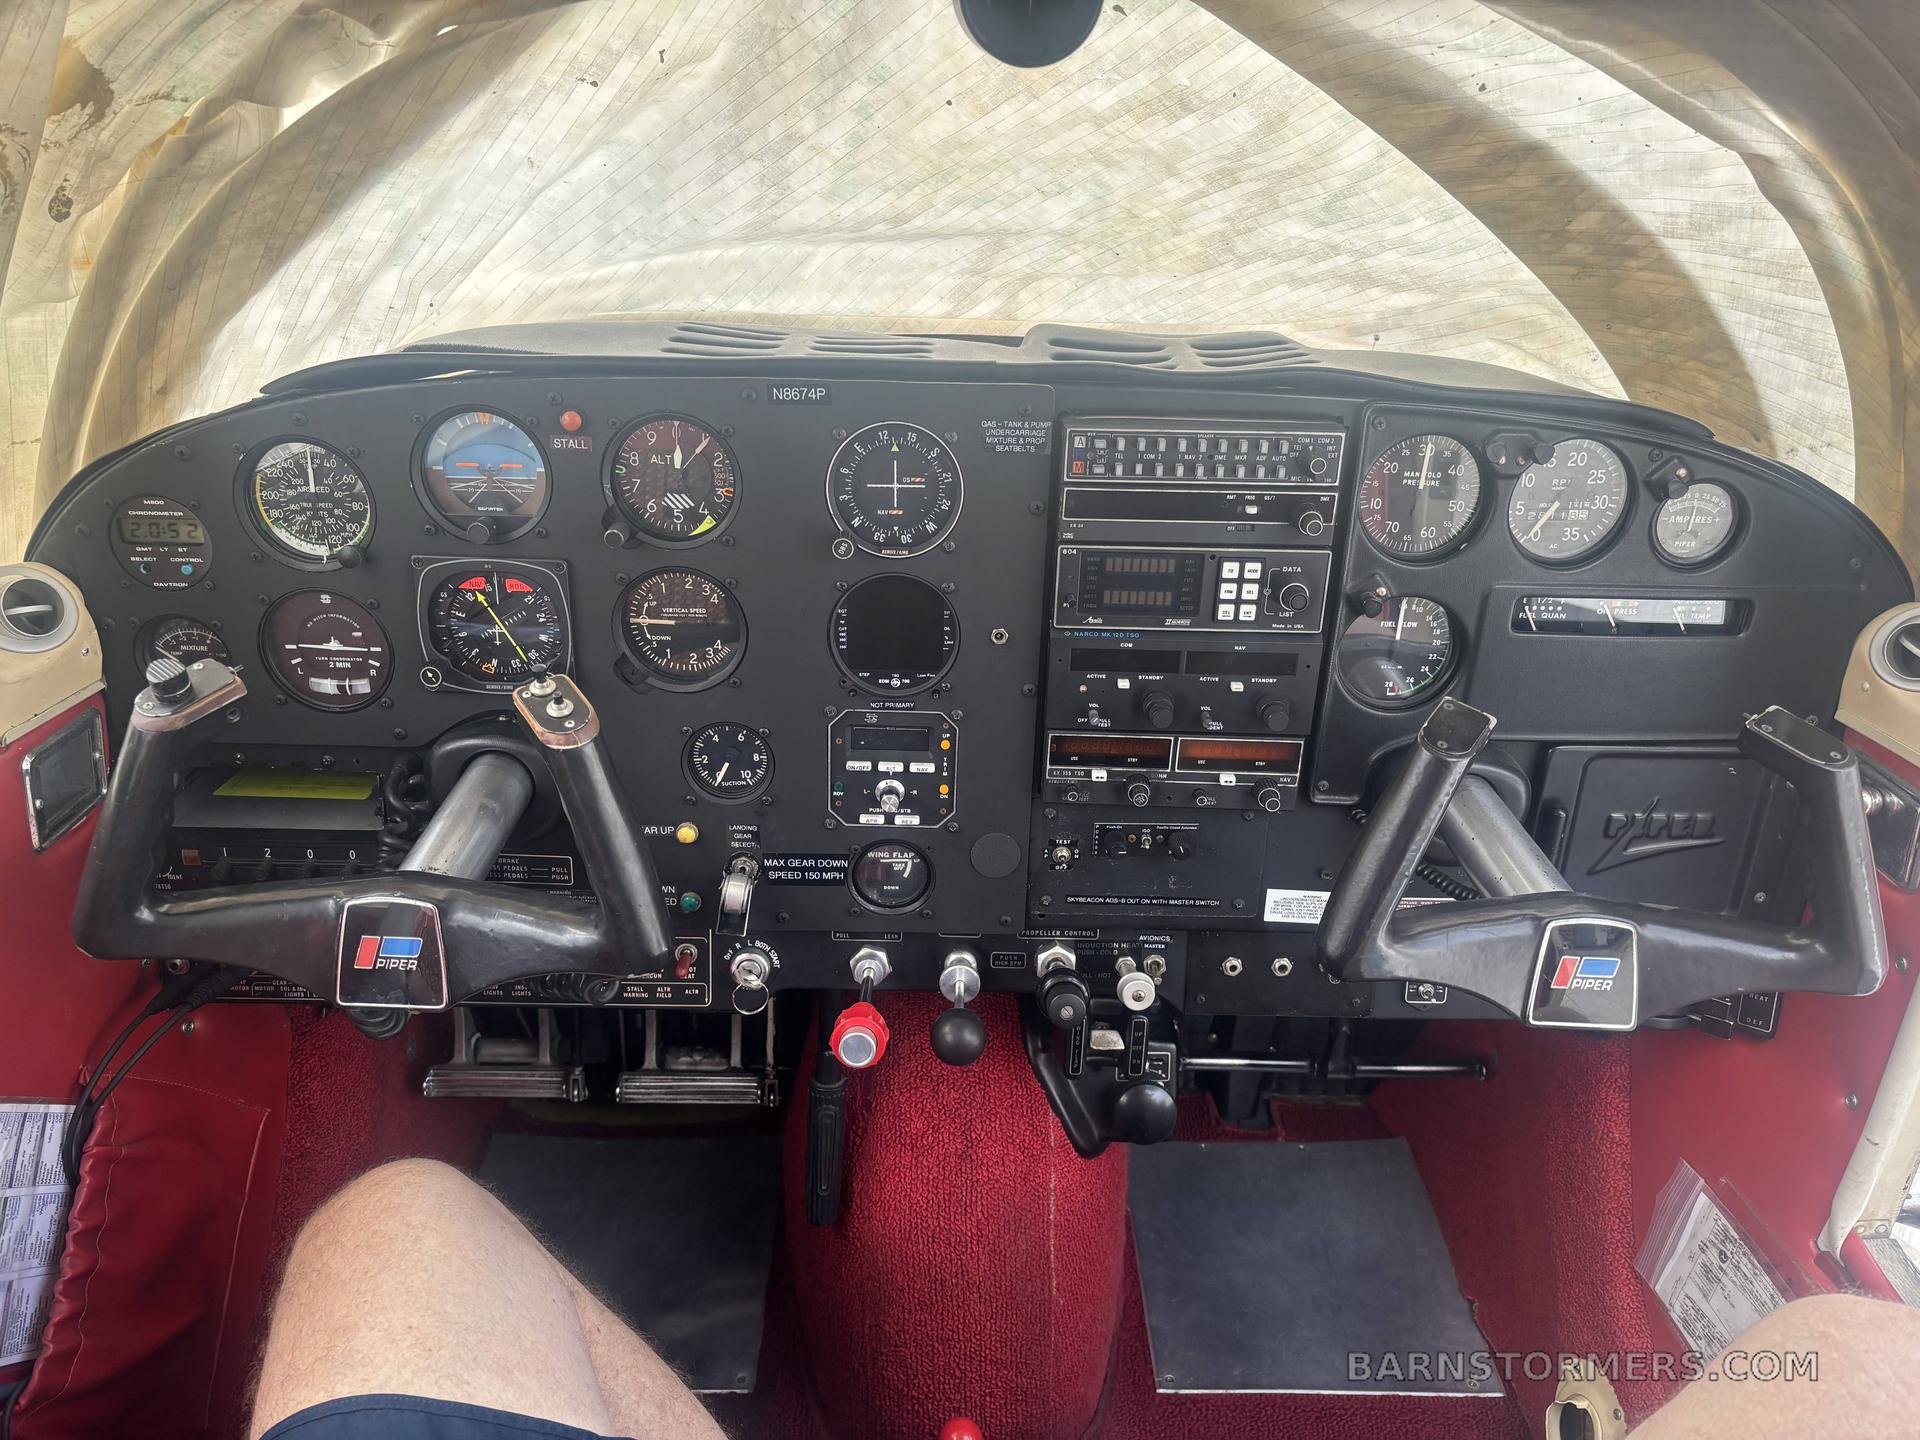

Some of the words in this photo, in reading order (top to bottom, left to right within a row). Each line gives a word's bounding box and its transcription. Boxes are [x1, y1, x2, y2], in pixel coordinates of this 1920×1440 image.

[773, 388, 826, 401] N8674P
[981, 420, 996, 428] GAS
[646, 431, 657, 445] 9
[878, 430, 889, 440] 12
[907, 432, 917, 442] 15
[554, 438, 589, 450] STALL
[276, 459, 294, 468] 240
[324, 460, 337, 468] 40
[630, 451, 639, 466] 8
[650, 455, 671, 465] ALT
[713, 452, 723, 467] 2
[1567, 452, 1588, 467] 20
[267, 469, 283, 478] 220
[1383, 462, 1399, 474] 20
[1447, 464, 1464, 476] 40
[343, 474, 355, 483] 60
[942, 472, 952, 483] 21
[1521, 473, 1535, 488] 10
[1587, 469, 1606, 485] 25
[632, 479, 641, 492] 7
[262, 491, 280, 500] 200
[352, 501, 364, 510] 80
[647, 499, 657, 513] 6
[699, 501, 709, 515] 4
[941, 499, 951, 510] 24
[1370, 498, 1382, 510] 10
[1448, 501, 1465, 512] 50
[1515, 501, 1525, 515] 5
[1591, 495, 1609, 510] 30
[269, 509, 284, 518] 180
[673, 509, 684, 523] 5
[346, 523, 360, 532] 100
[1385, 521, 1400, 533] 70
[1420, 527, 1436, 538] 60
[328, 535, 342, 544] 120
[1562, 527, 1580, 541] 35
[838, 542, 848, 554] OBS
[685, 577, 694, 589] 2
[702, 584, 710, 596] 3
[710, 593, 719, 604] 4
[713, 640, 722, 650] 4
[705, 647, 714, 658] 3
[689, 653, 698, 664] 2
[737, 733, 745, 742] 6
[701, 755, 709, 764] 2
[753, 753, 760, 762] 8
[740, 770, 752, 779] 10
[660, 826, 675, 835] UP
[264, 848, 272, 858] 2
[307, 849, 314, 859] 0
[349, 849, 356, 860] 0
[764, 859, 785, 867] MAX
[787, 859, 815, 868] GEAR
[817, 859, 849, 868] DOWN
[768, 871, 801, 880] SPEED
[804, 871, 821, 880] 150
[822, 872, 844, 880] MPH
[754, 940, 771, 952] BOTH
[375, 958, 418, 971] PIPER
[768, 949, 781, 969] START
[1571, 979, 1614, 991] PIPER
[1746, 1017, 1764, 1027] DEF
